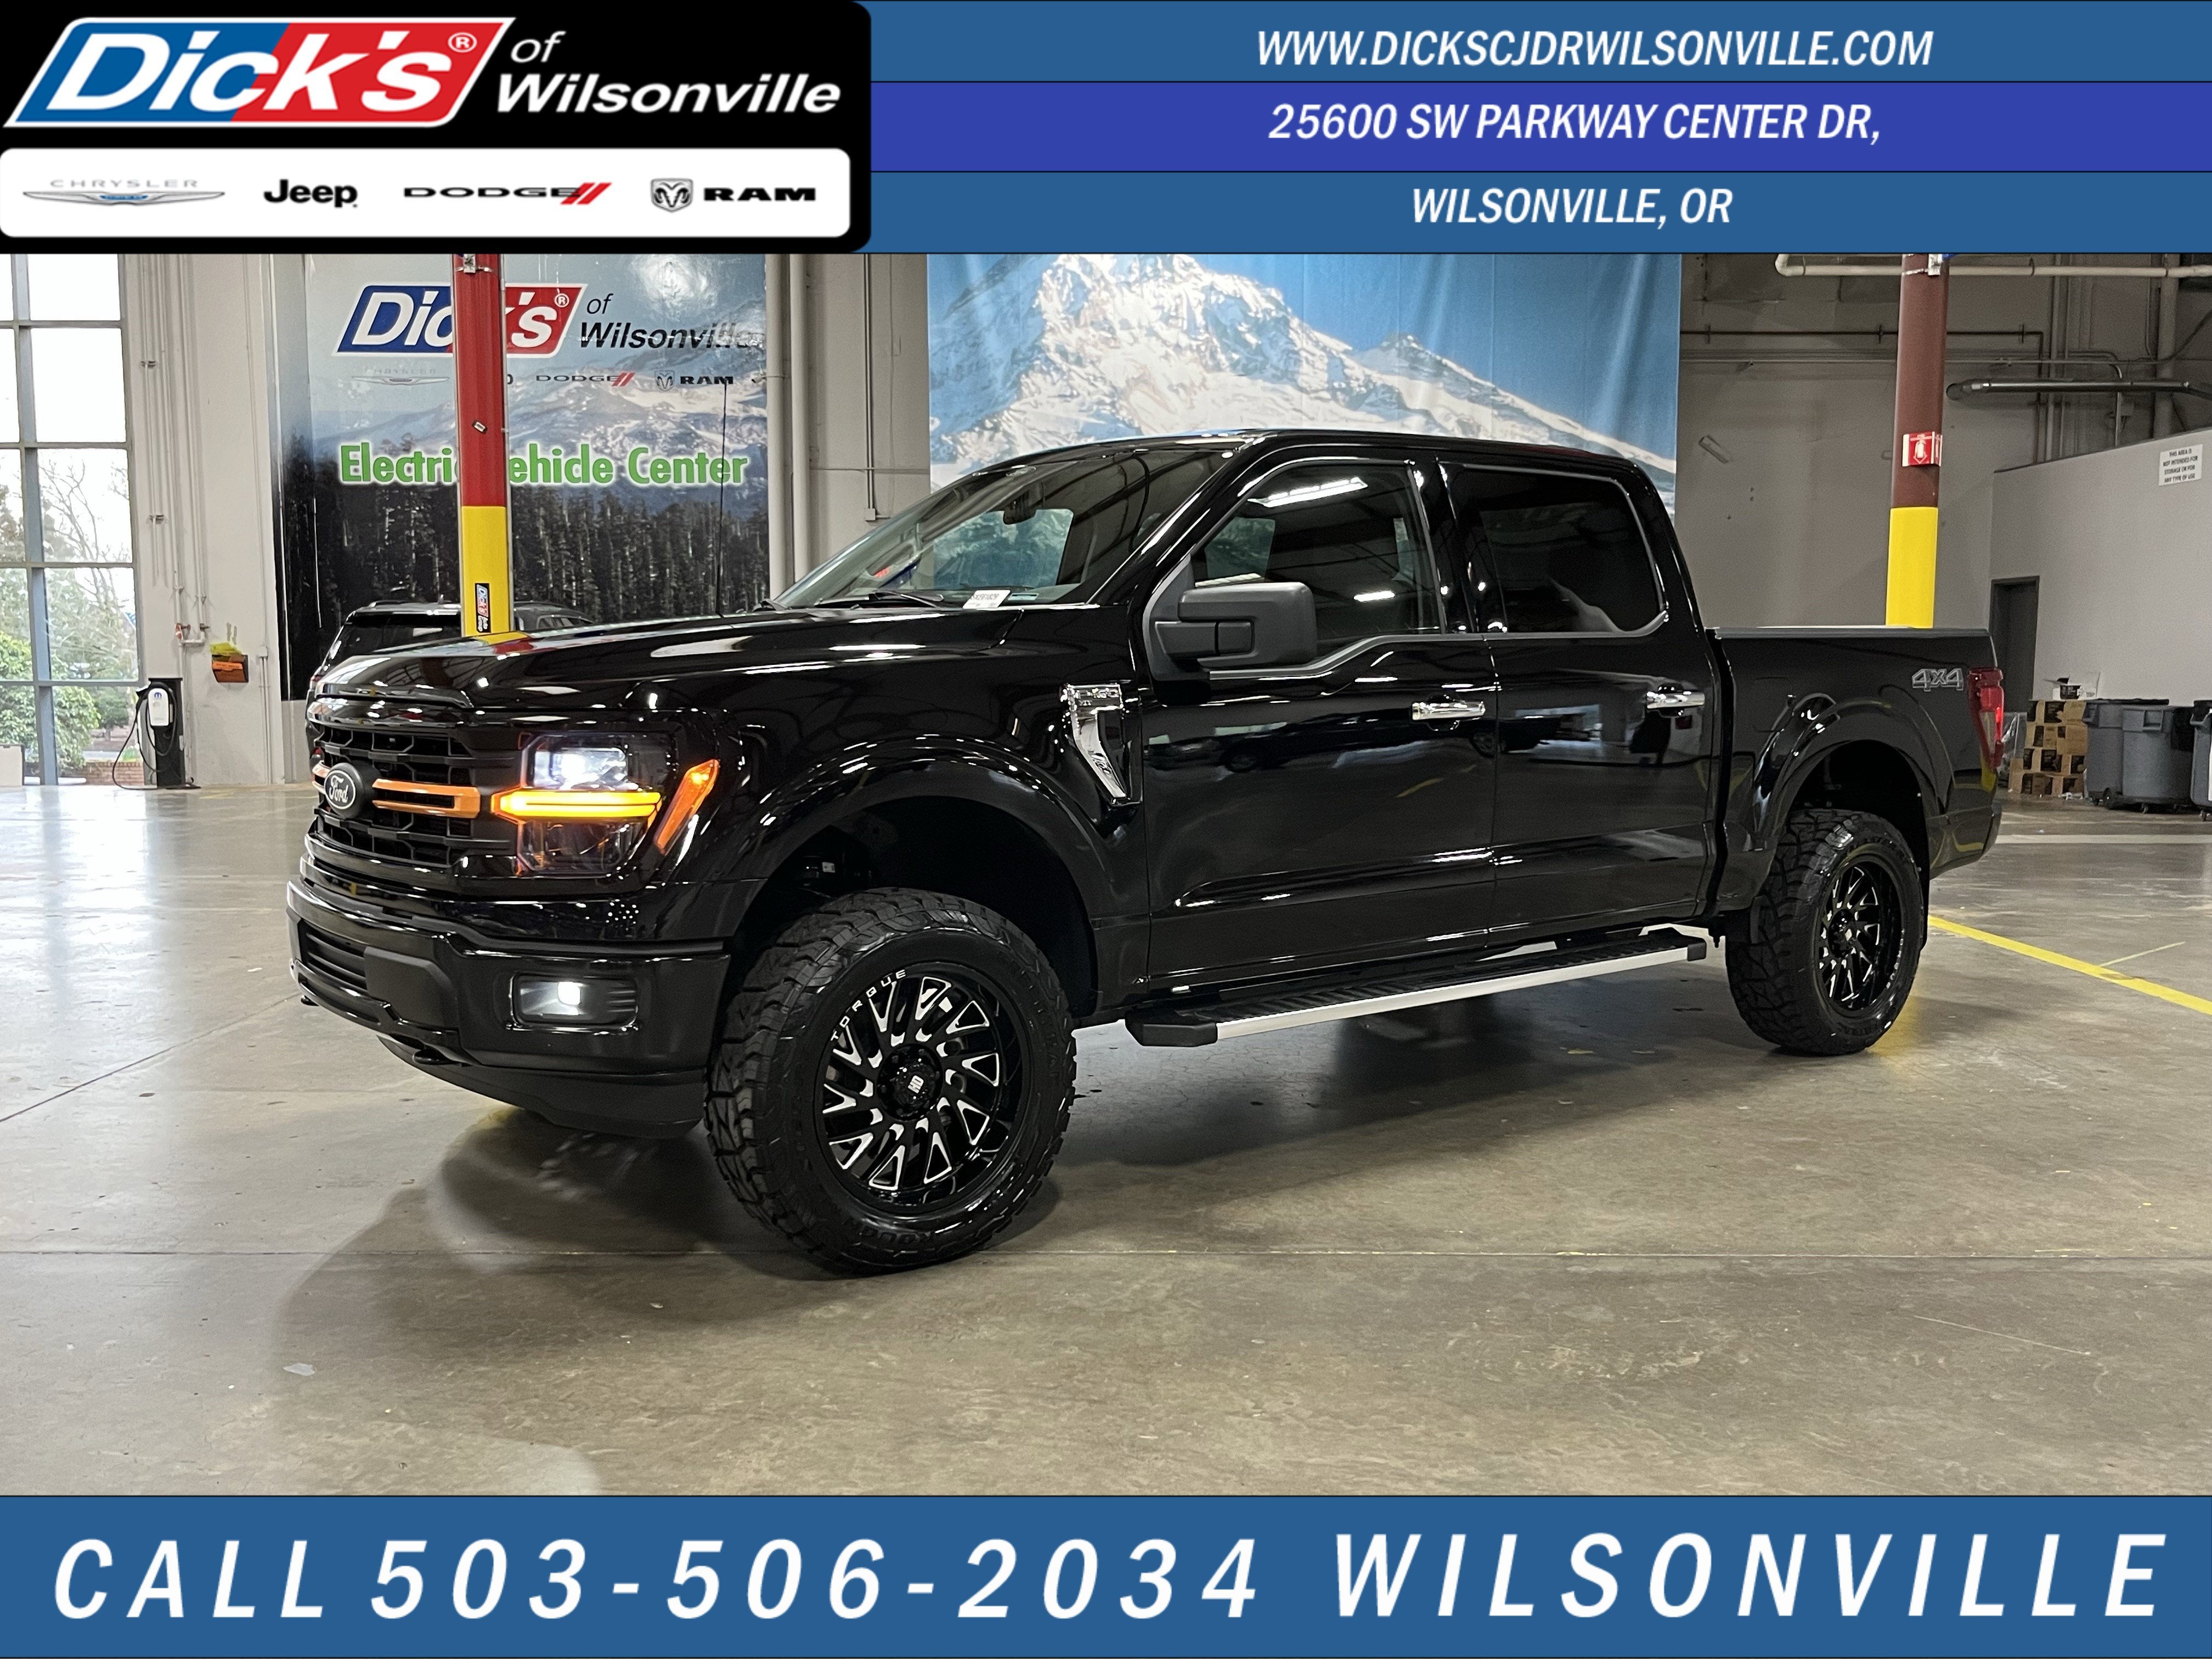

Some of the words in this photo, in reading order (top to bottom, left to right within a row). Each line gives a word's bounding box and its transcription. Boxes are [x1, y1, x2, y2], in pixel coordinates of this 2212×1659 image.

[352, 291, 557, 348] Dic's
[586, 293, 613, 314] of
[680, 376, 734, 385] RAM
[341, 442, 457, 482] Electri
[509, 443, 613, 484] ehicle
[628, 447, 747, 484] Center
[329, 775, 349, 804] Ford
[831, 969, 906, 1041] TORQUE
